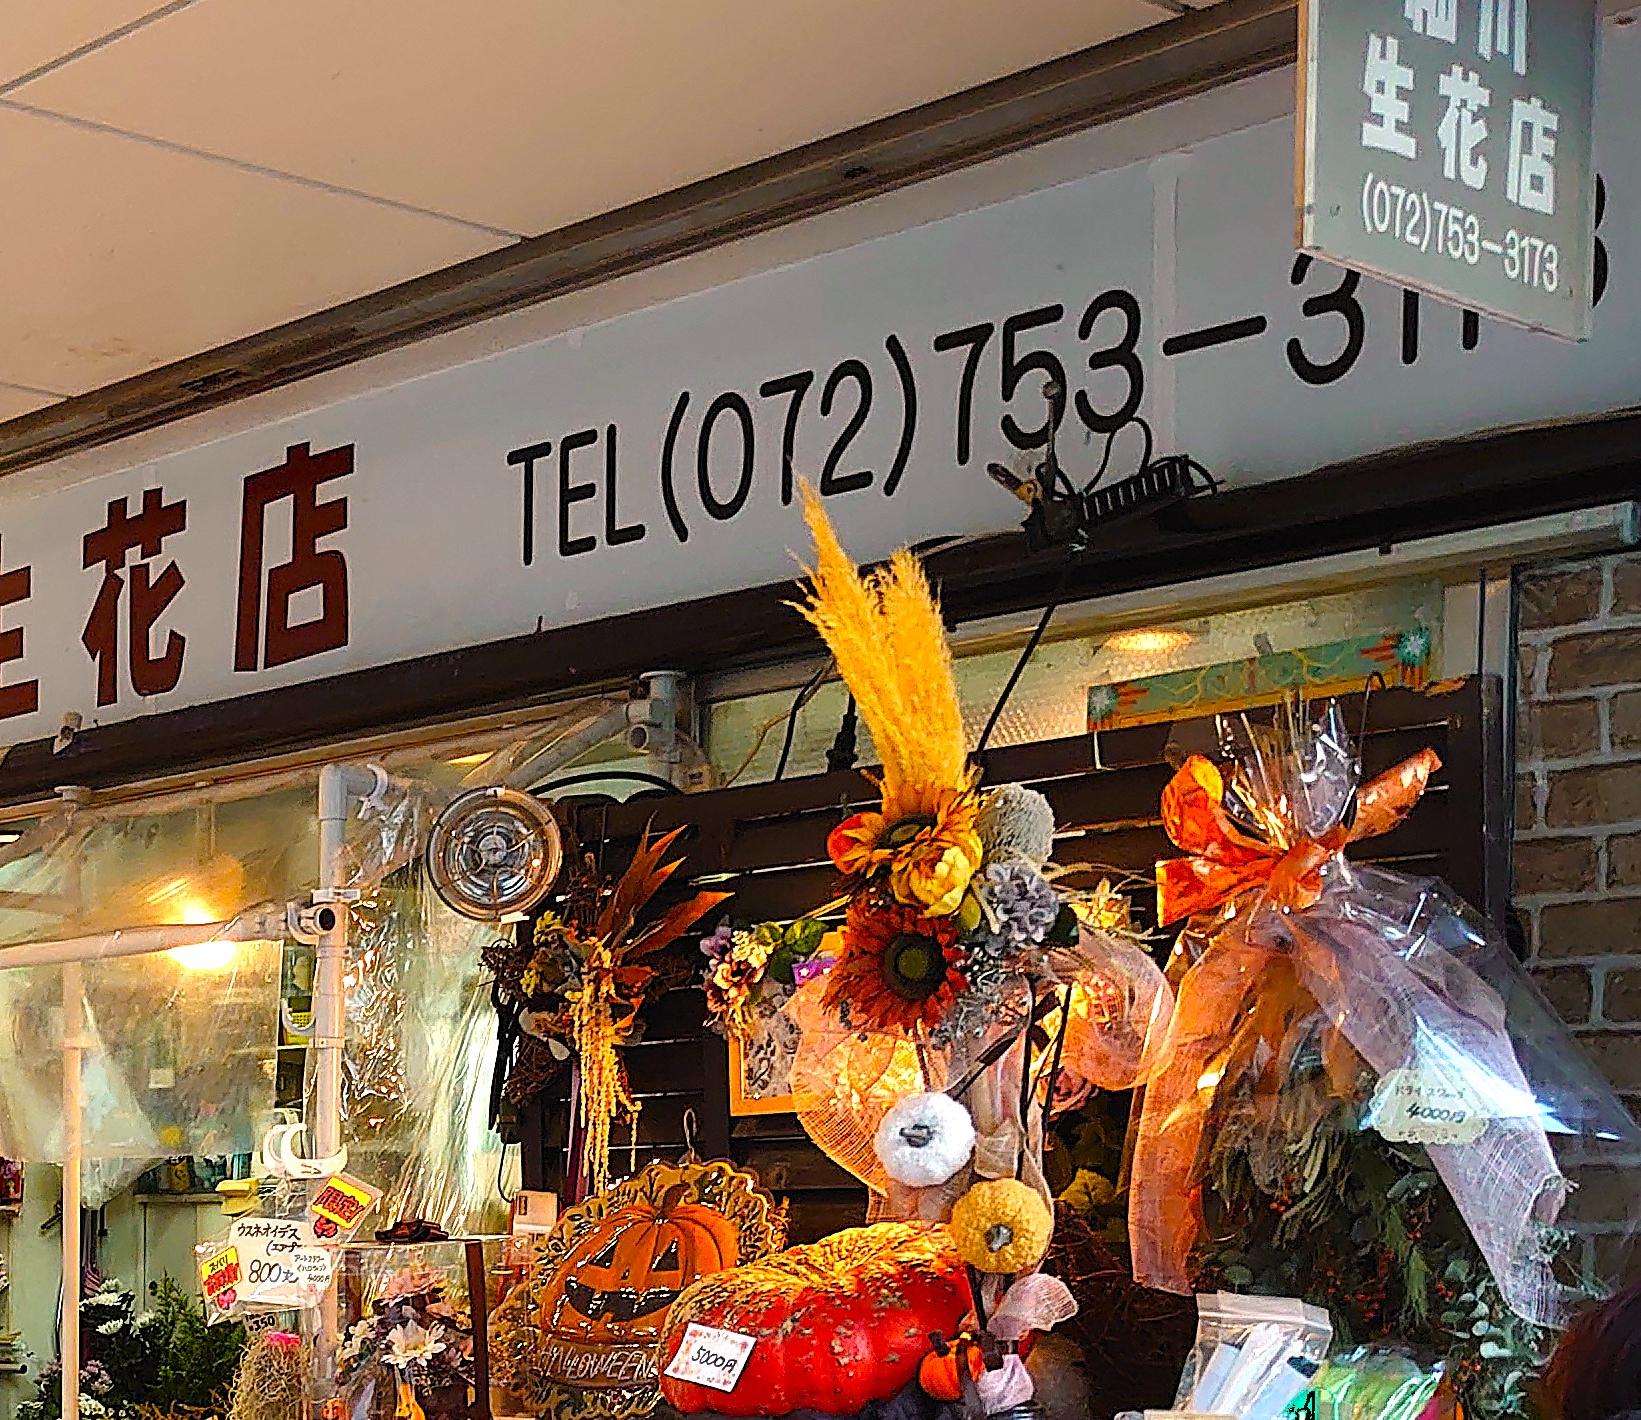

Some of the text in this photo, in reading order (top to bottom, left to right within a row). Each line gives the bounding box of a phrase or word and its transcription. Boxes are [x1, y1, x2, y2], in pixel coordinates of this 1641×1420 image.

[1361, 32, 1559, 215] 生花店
[507, 422, 646, 566] TEL
